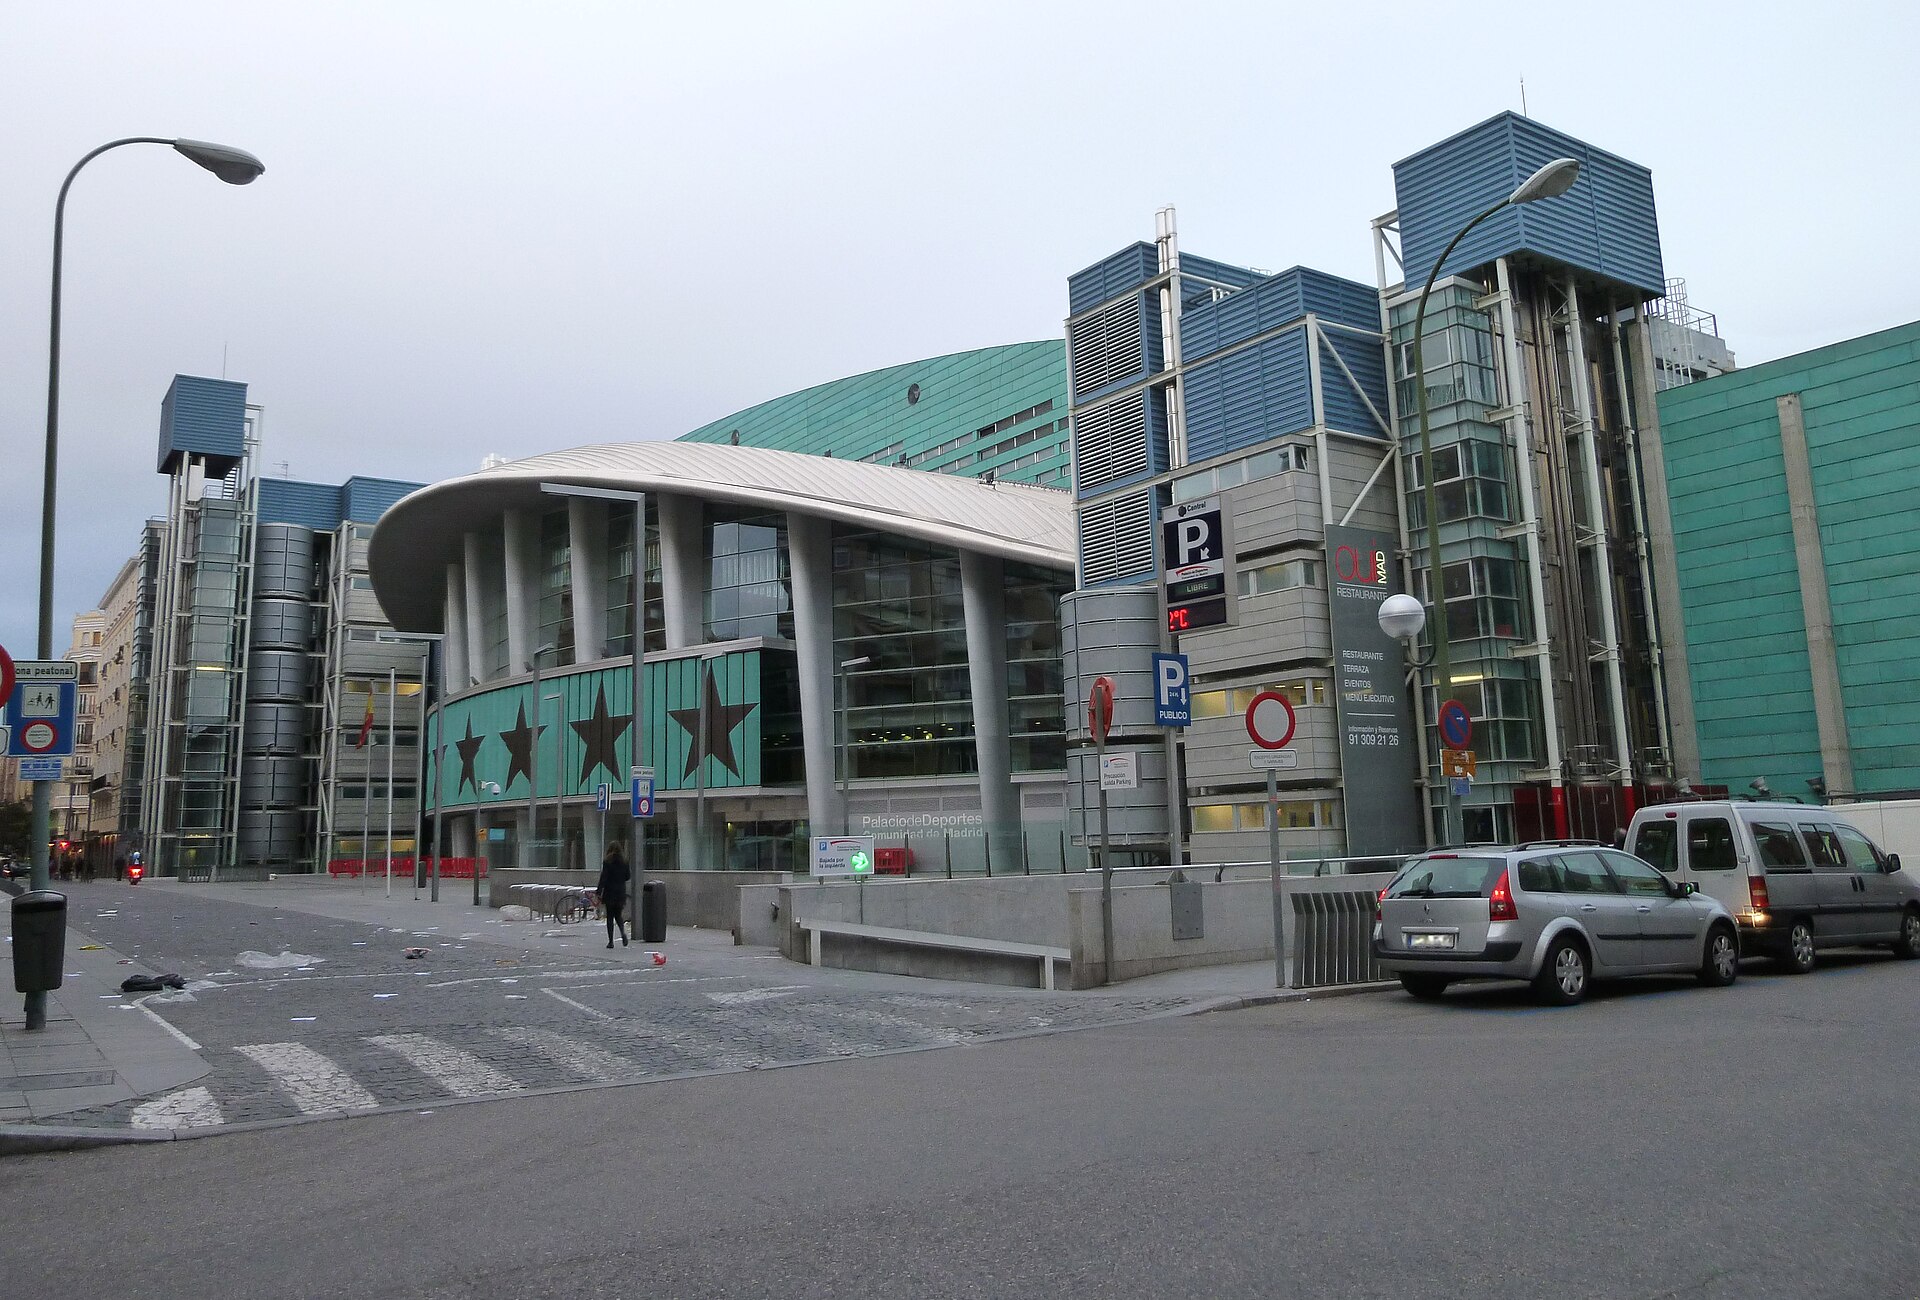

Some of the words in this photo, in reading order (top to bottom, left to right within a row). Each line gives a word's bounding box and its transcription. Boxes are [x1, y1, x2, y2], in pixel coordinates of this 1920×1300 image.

[1187, 501, 1206, 511] Central
[1178, 518, 1209, 565] P
[1376, 551, 1387, 584] MAD
[1186, 582, 1208, 592] LIBRE
[1337, 587, 1388, 600] RESTAURANTE
[1342, 650, 1384, 660] RESTAURANTE
[35, 665, 73, 677] peatonal
[1343, 664, 1369, 674] TERRAZA
[1159, 660, 1184, 705] P
[1344, 679, 1371, 688] EVENTOS
[1364, 694, 1394, 703] EJECUTIVO
[1349, 734, 1358, 745] 91
[1361, 734, 1376, 745] 309
[1377, 735, 1386, 745] 21
[1389, 735, 1399, 746] 26
[944, 827, 983, 838] Madrid
